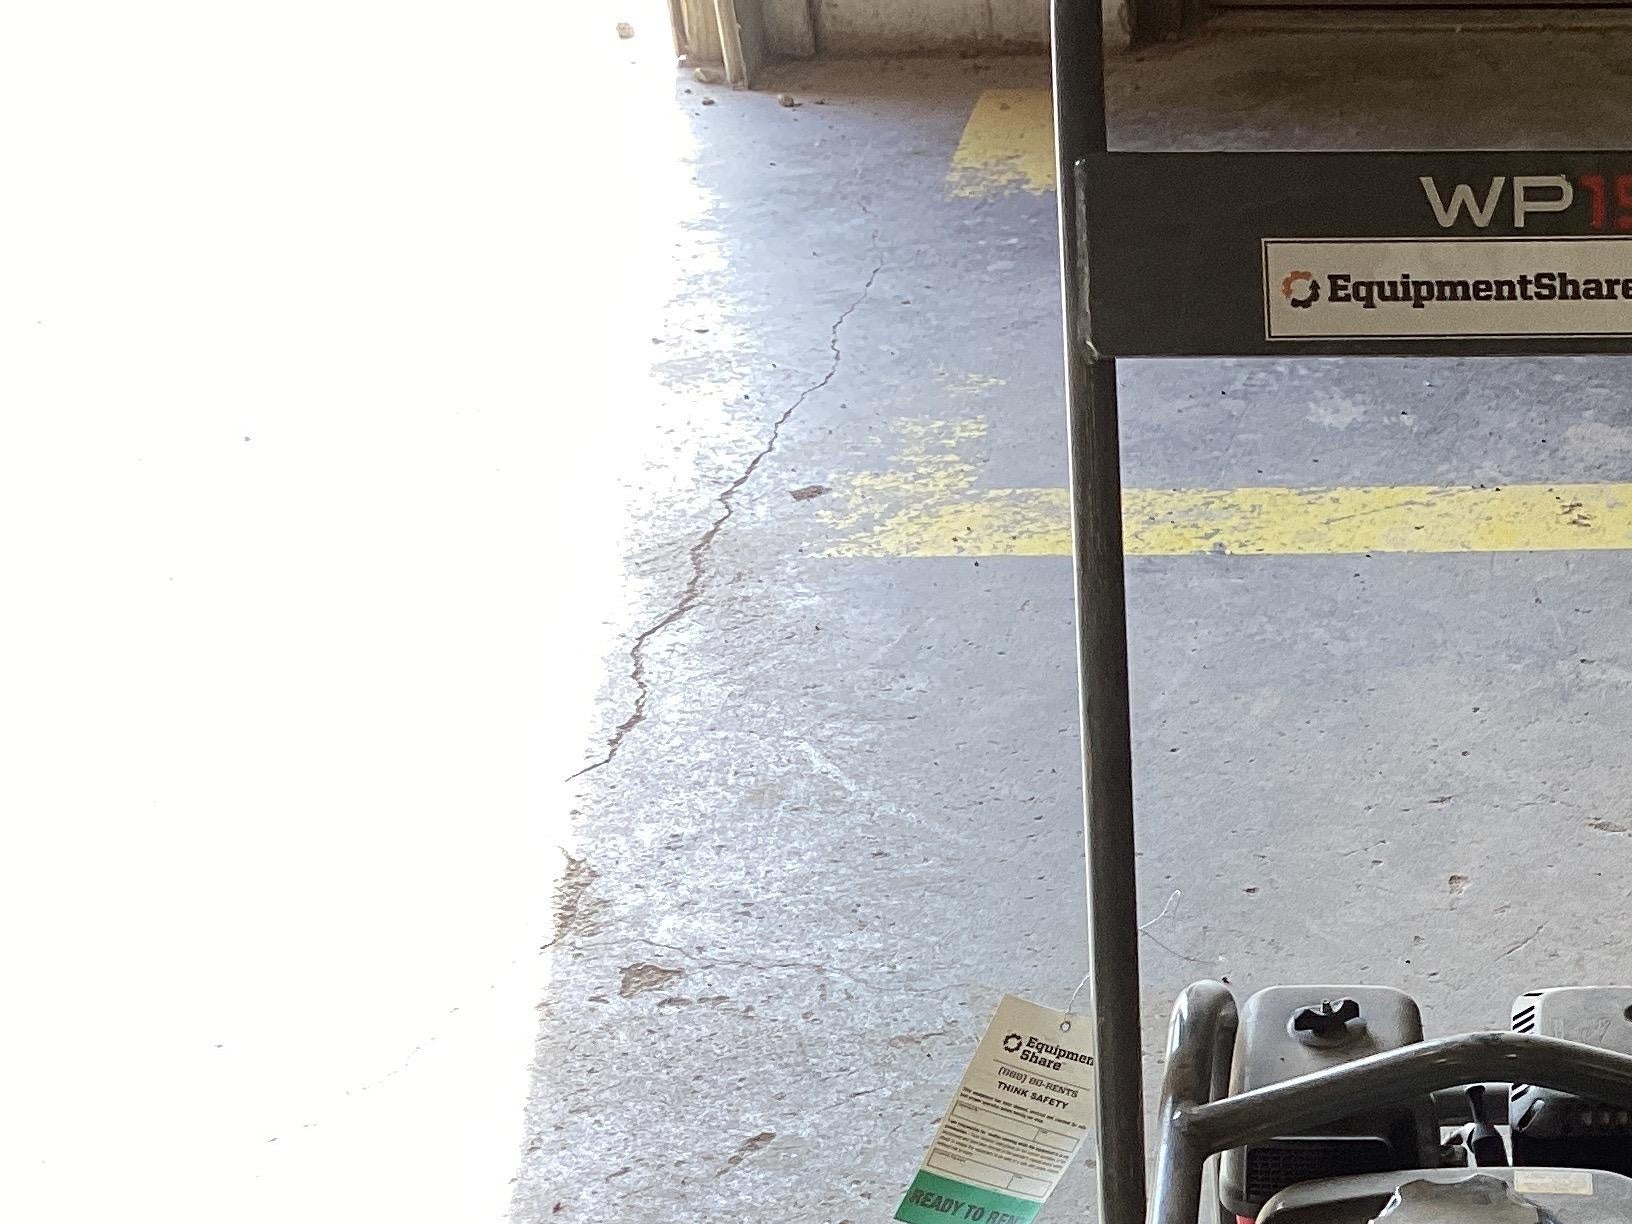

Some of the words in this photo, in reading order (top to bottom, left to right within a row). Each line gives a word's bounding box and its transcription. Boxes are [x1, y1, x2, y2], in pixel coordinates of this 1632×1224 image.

[1020, 1049, 1062, 1071] Share
[1026, 1036, 1094, 1066] Equipmen
[997, 1081, 1029, 1098] THINK
[1030, 1092, 1069, 1110] SAFETY
[908, 1188, 965, 1216] READY
[963, 1204, 985, 1222] TO
